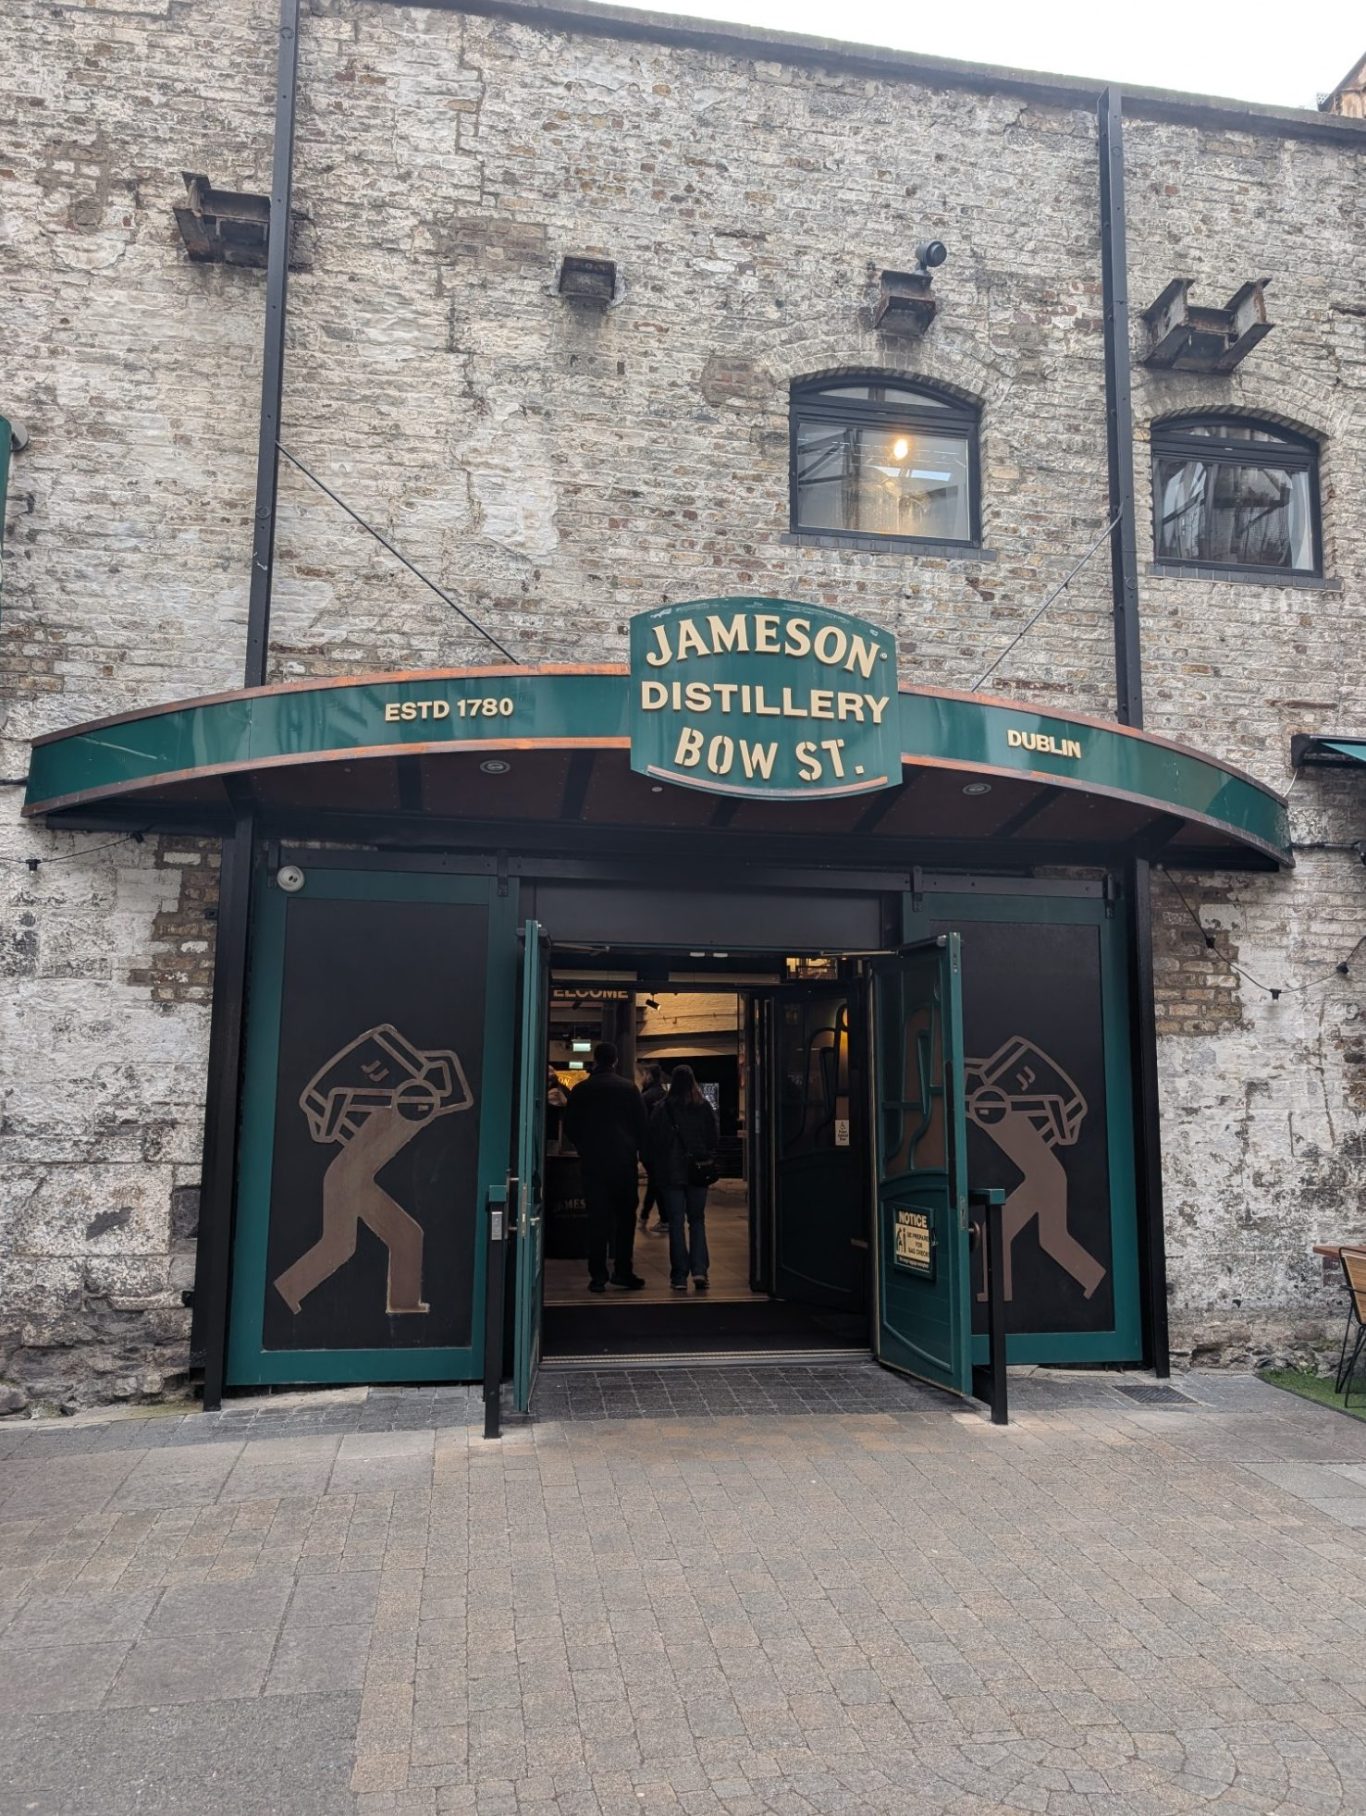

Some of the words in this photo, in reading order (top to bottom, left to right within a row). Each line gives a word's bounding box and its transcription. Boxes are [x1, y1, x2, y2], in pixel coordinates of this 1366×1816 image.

[646, 613, 881, 680] JAMESON
[384, 699, 450, 722] ESTD
[457, 697, 514, 717] 1780
[641, 680, 890, 724] DISTILLERY
[674, 726, 778, 780] BOW
[795, 738, 865, 782] ST.
[1007, 729, 1082, 759] DUBLIN
[898, 1211, 928, 1228] NOTICE
